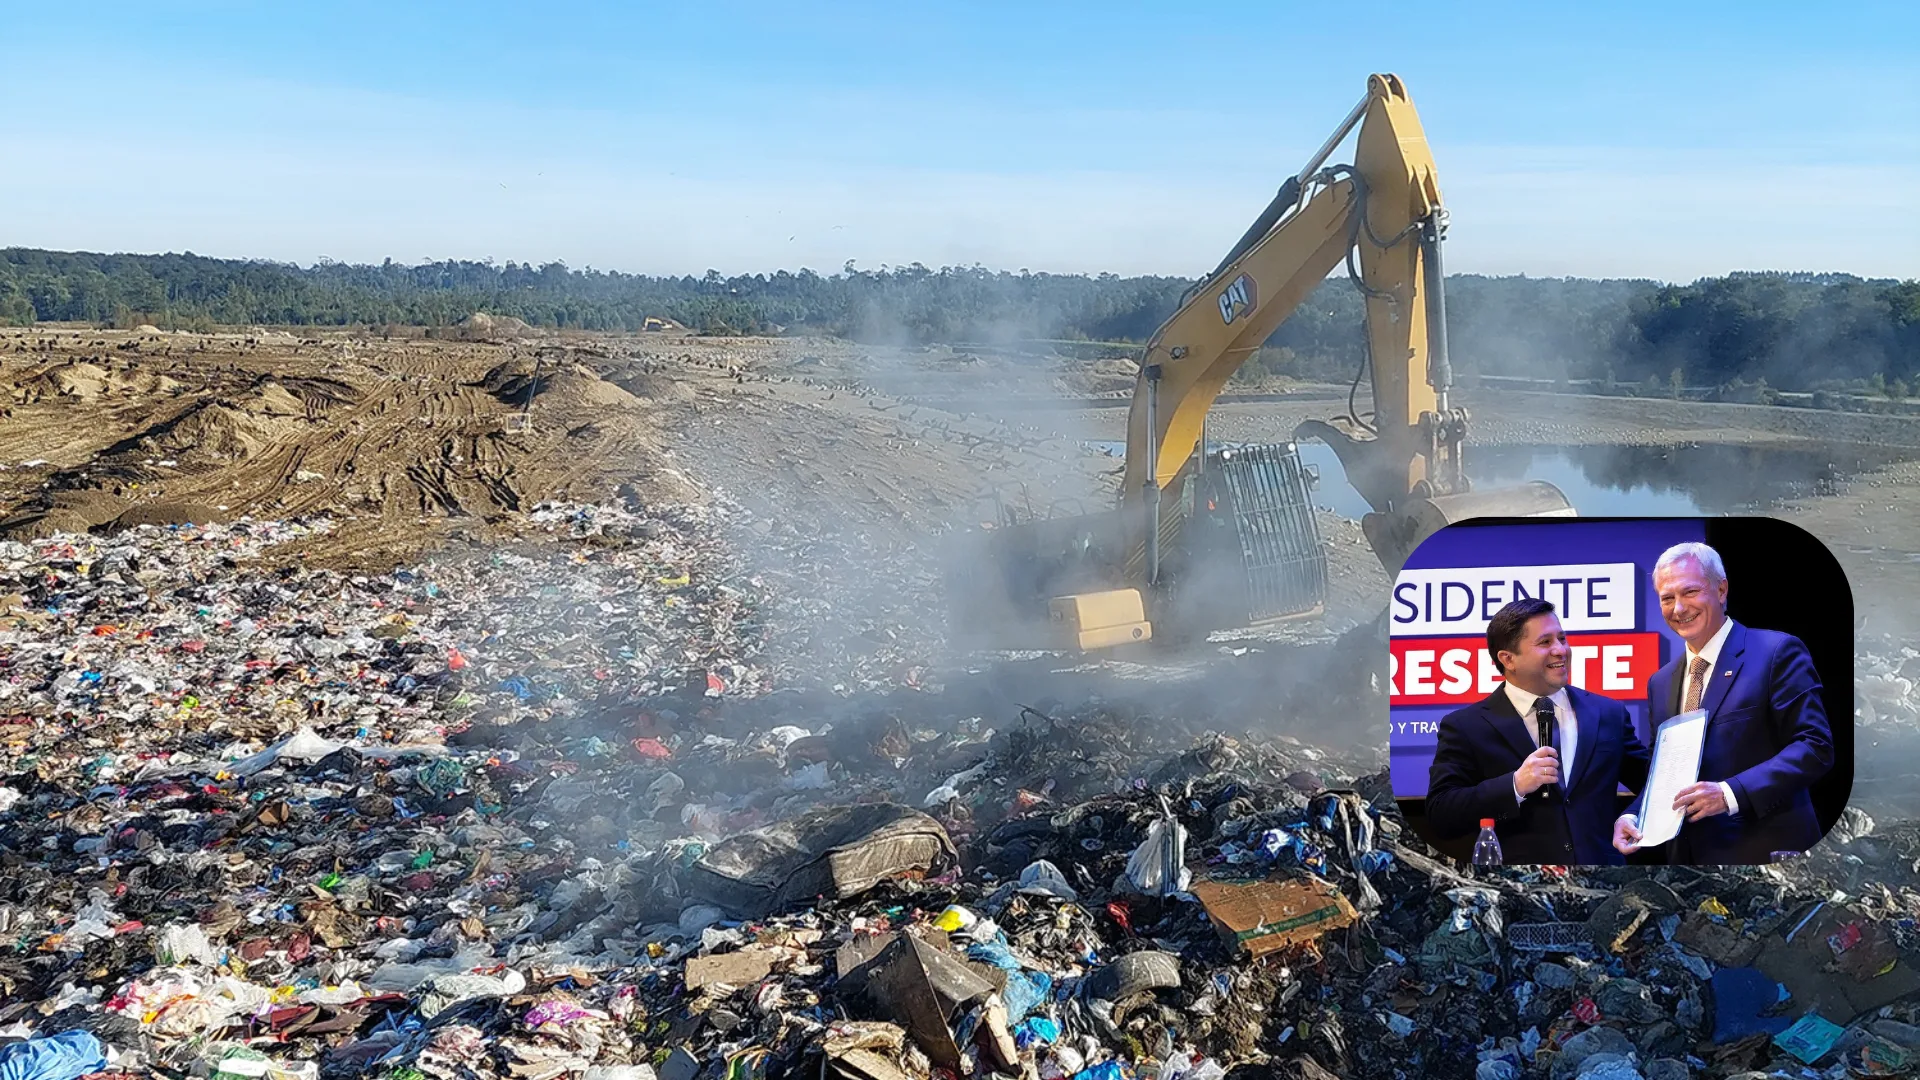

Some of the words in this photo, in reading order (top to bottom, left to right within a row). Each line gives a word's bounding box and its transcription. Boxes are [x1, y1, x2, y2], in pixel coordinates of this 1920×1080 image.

[1219, 276, 1249, 323] CAT
[1390, 644, 1635, 696] ESETE
[1398, 722, 1407, 734] Y
[1410, 721, 1440, 734] TRA
